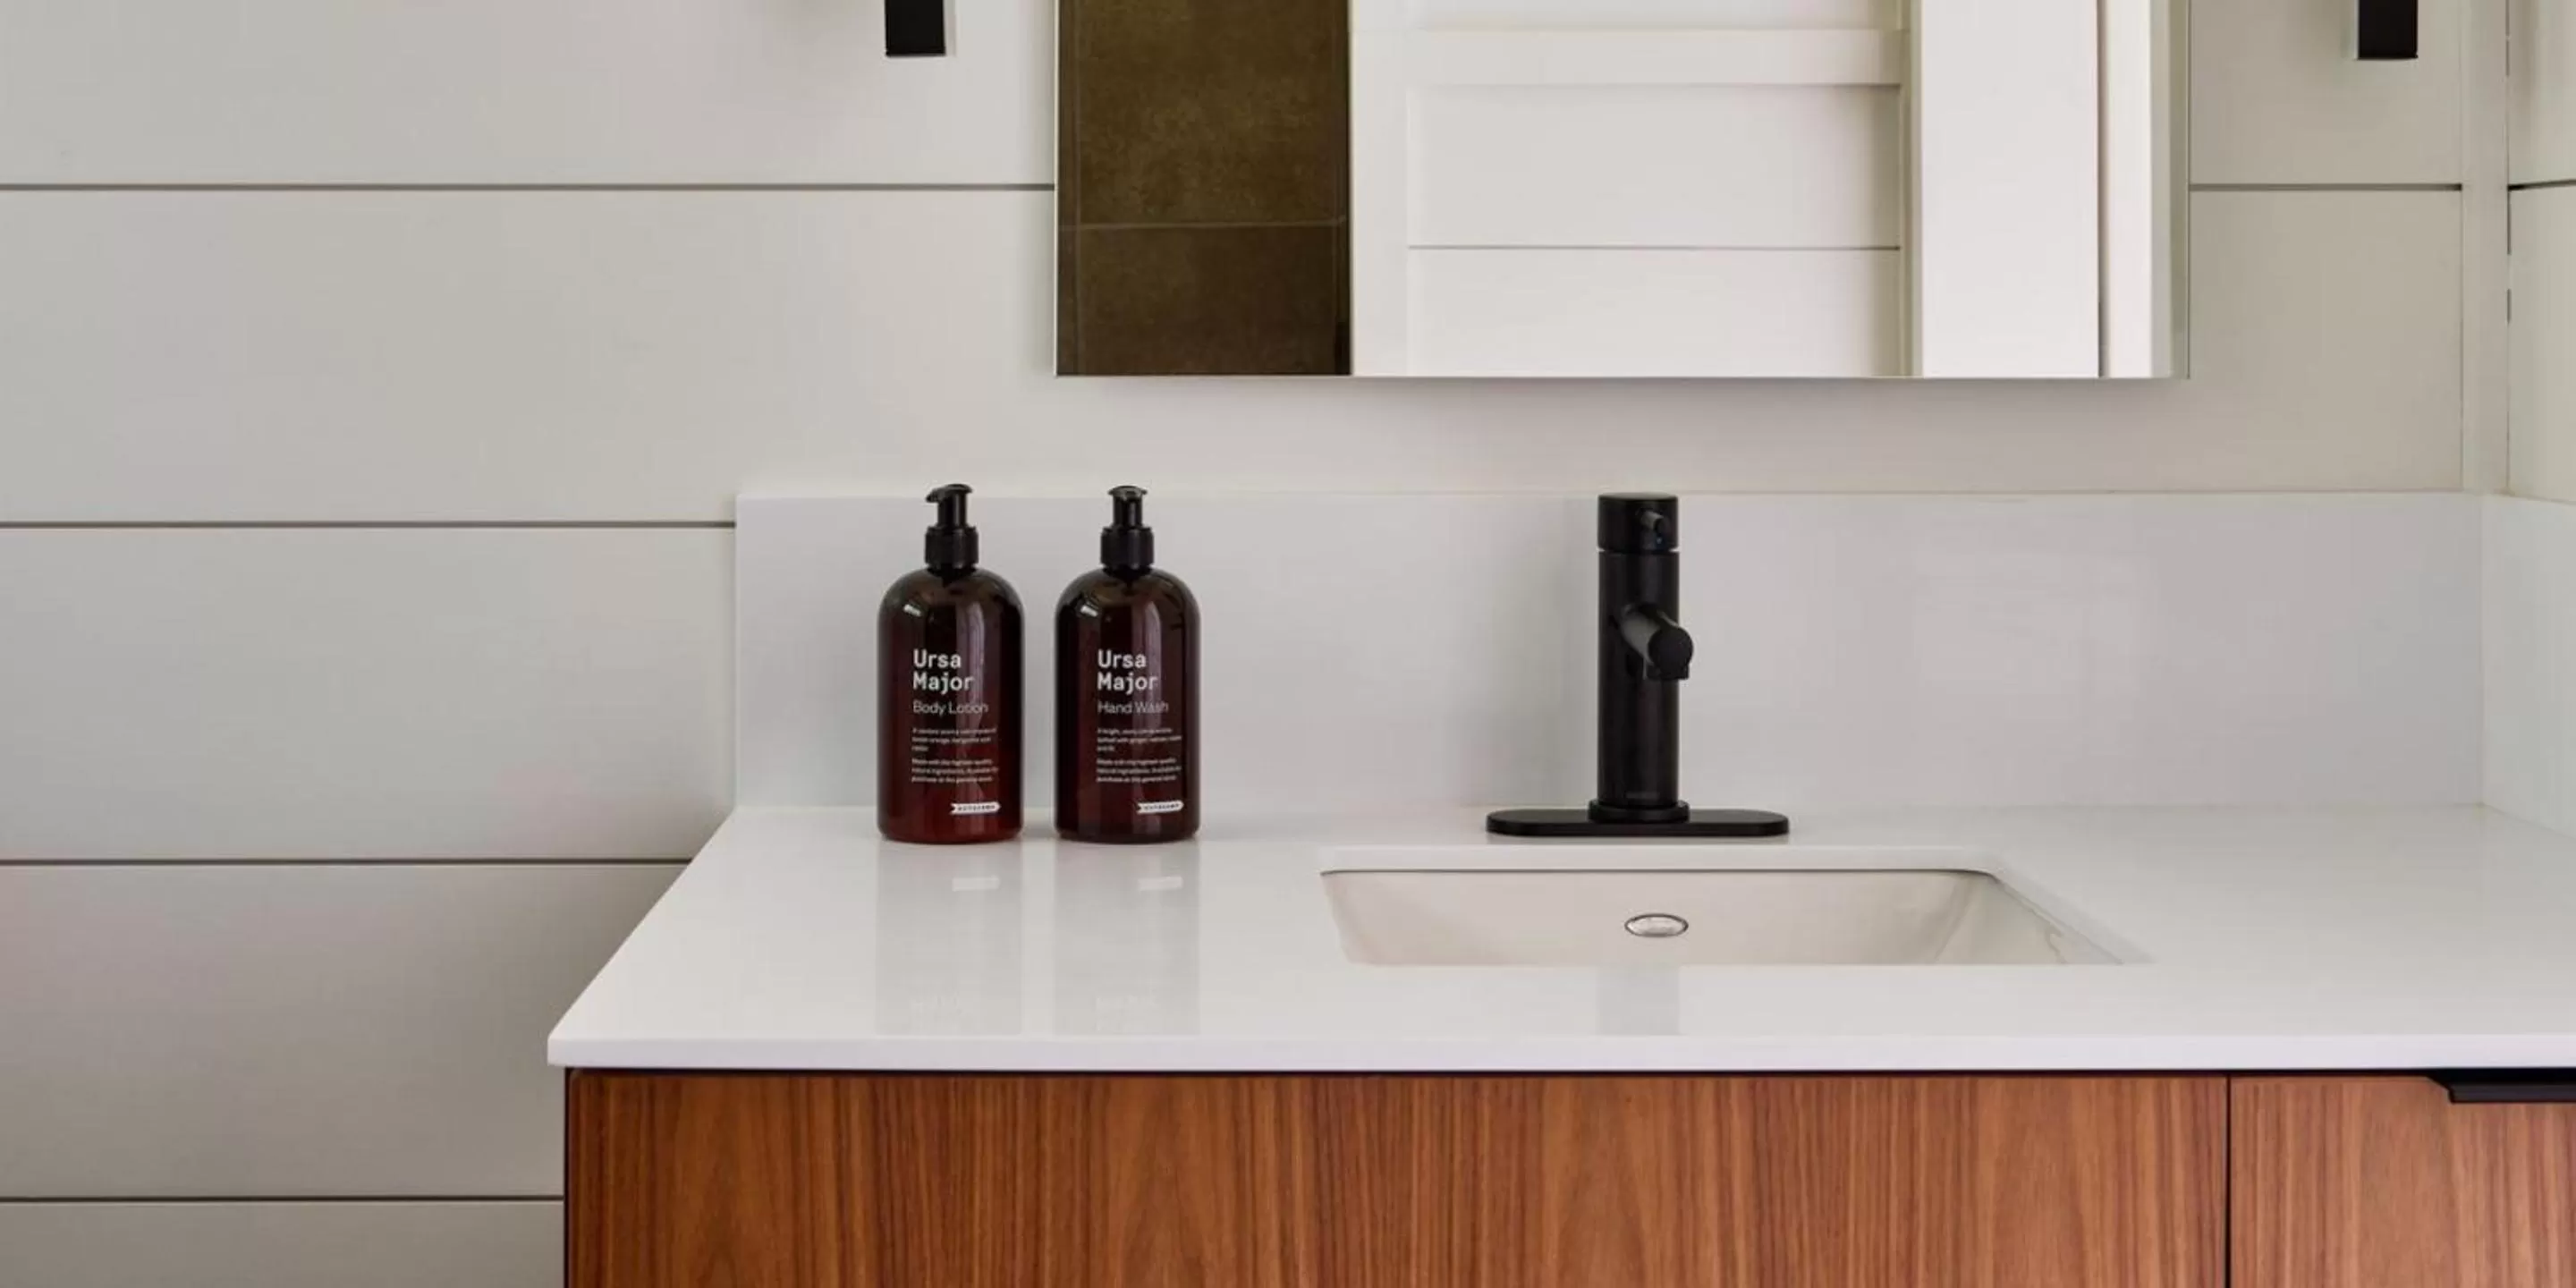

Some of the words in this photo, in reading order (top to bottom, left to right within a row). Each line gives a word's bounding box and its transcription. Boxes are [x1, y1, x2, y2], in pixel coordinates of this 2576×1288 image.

[913, 649, 961, 668] Ursa
[1097, 649, 1146, 668] Ursa
[912, 671, 974, 695] Major
[1097, 671, 1158, 695] Major
[913, 699, 946, 716] Body
[1097, 700, 1132, 714] Hand
[1134, 700, 1169, 714] Wash
